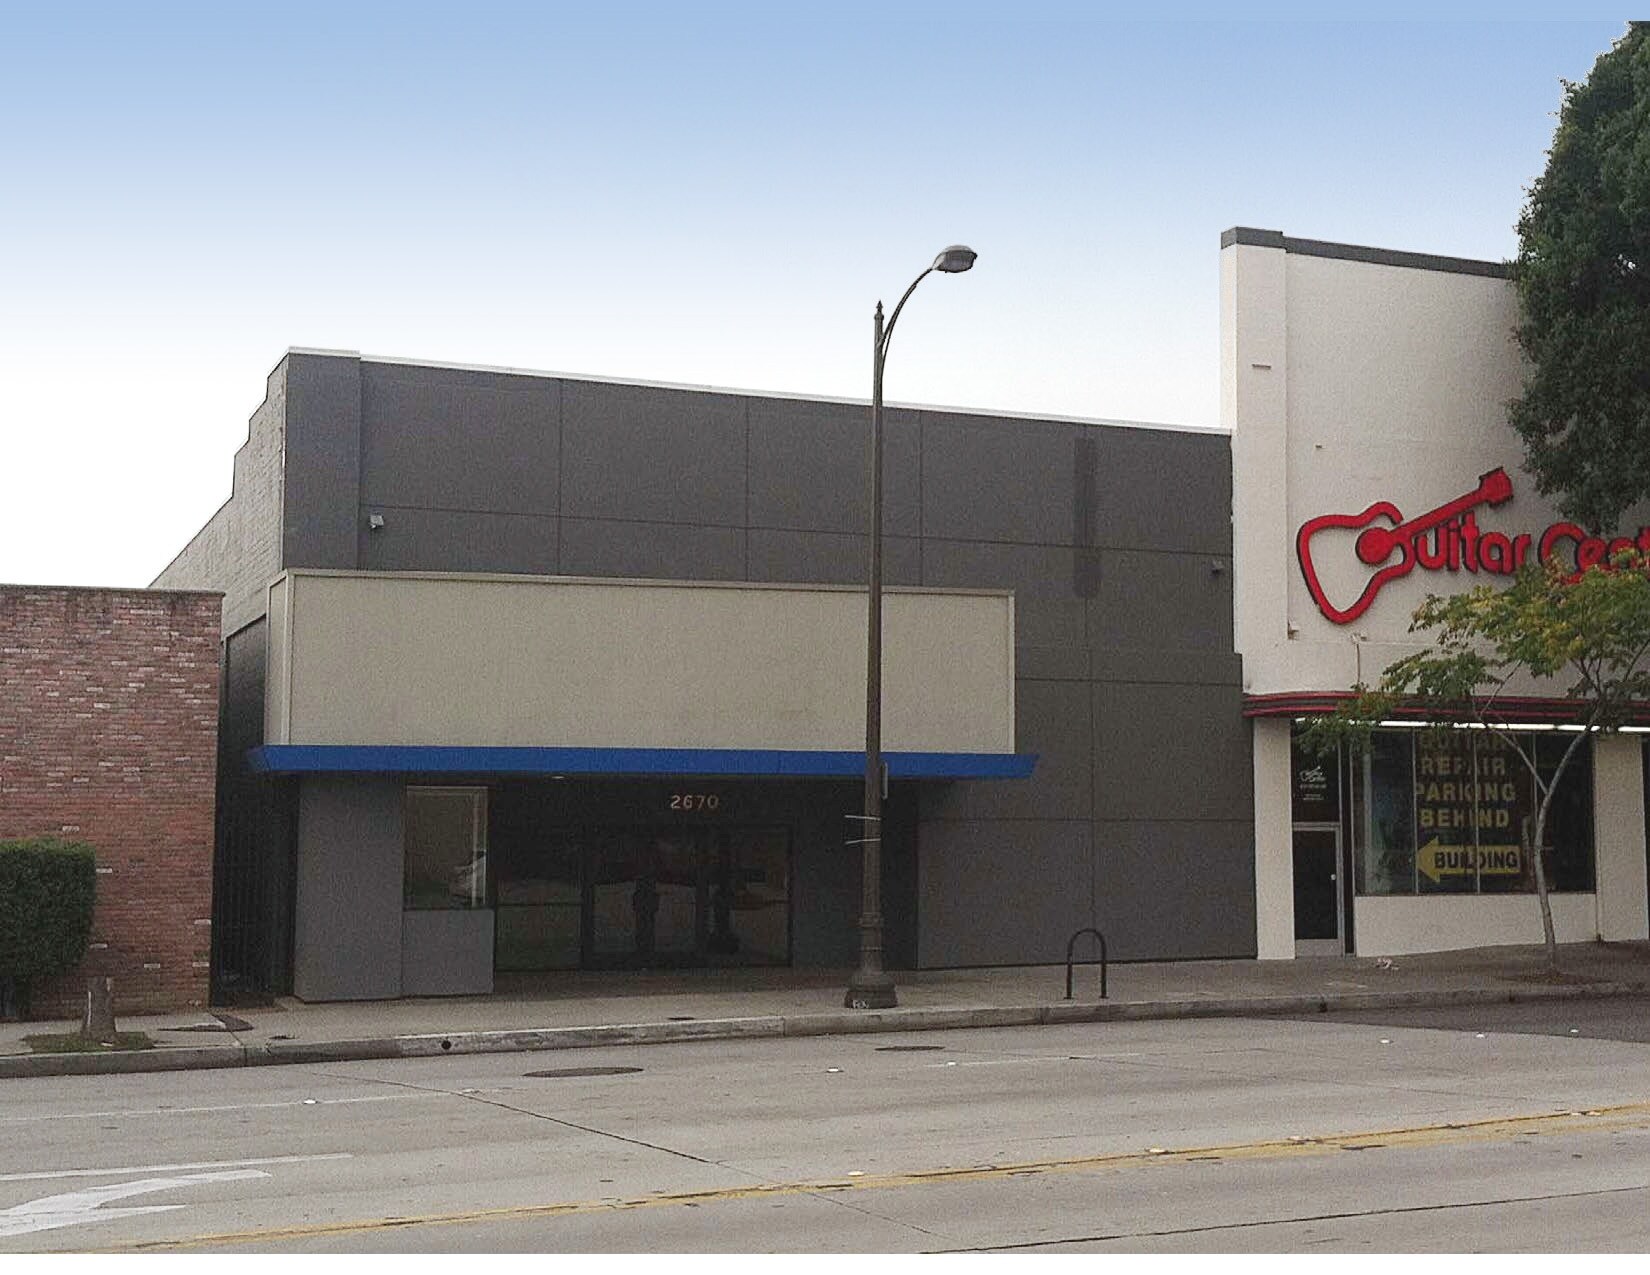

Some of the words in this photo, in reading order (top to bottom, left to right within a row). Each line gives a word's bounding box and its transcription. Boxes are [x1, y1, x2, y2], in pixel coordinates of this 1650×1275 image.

[1296, 466, 1531, 625] Guitar
[1420, 756, 1505, 776] REPAIR
[670, 794, 720, 810] 2670
[1416, 782, 1517, 802] PARKING
[1419, 807, 1510, 828] BEHIND
[1434, 850, 1518, 869] BUILDING
